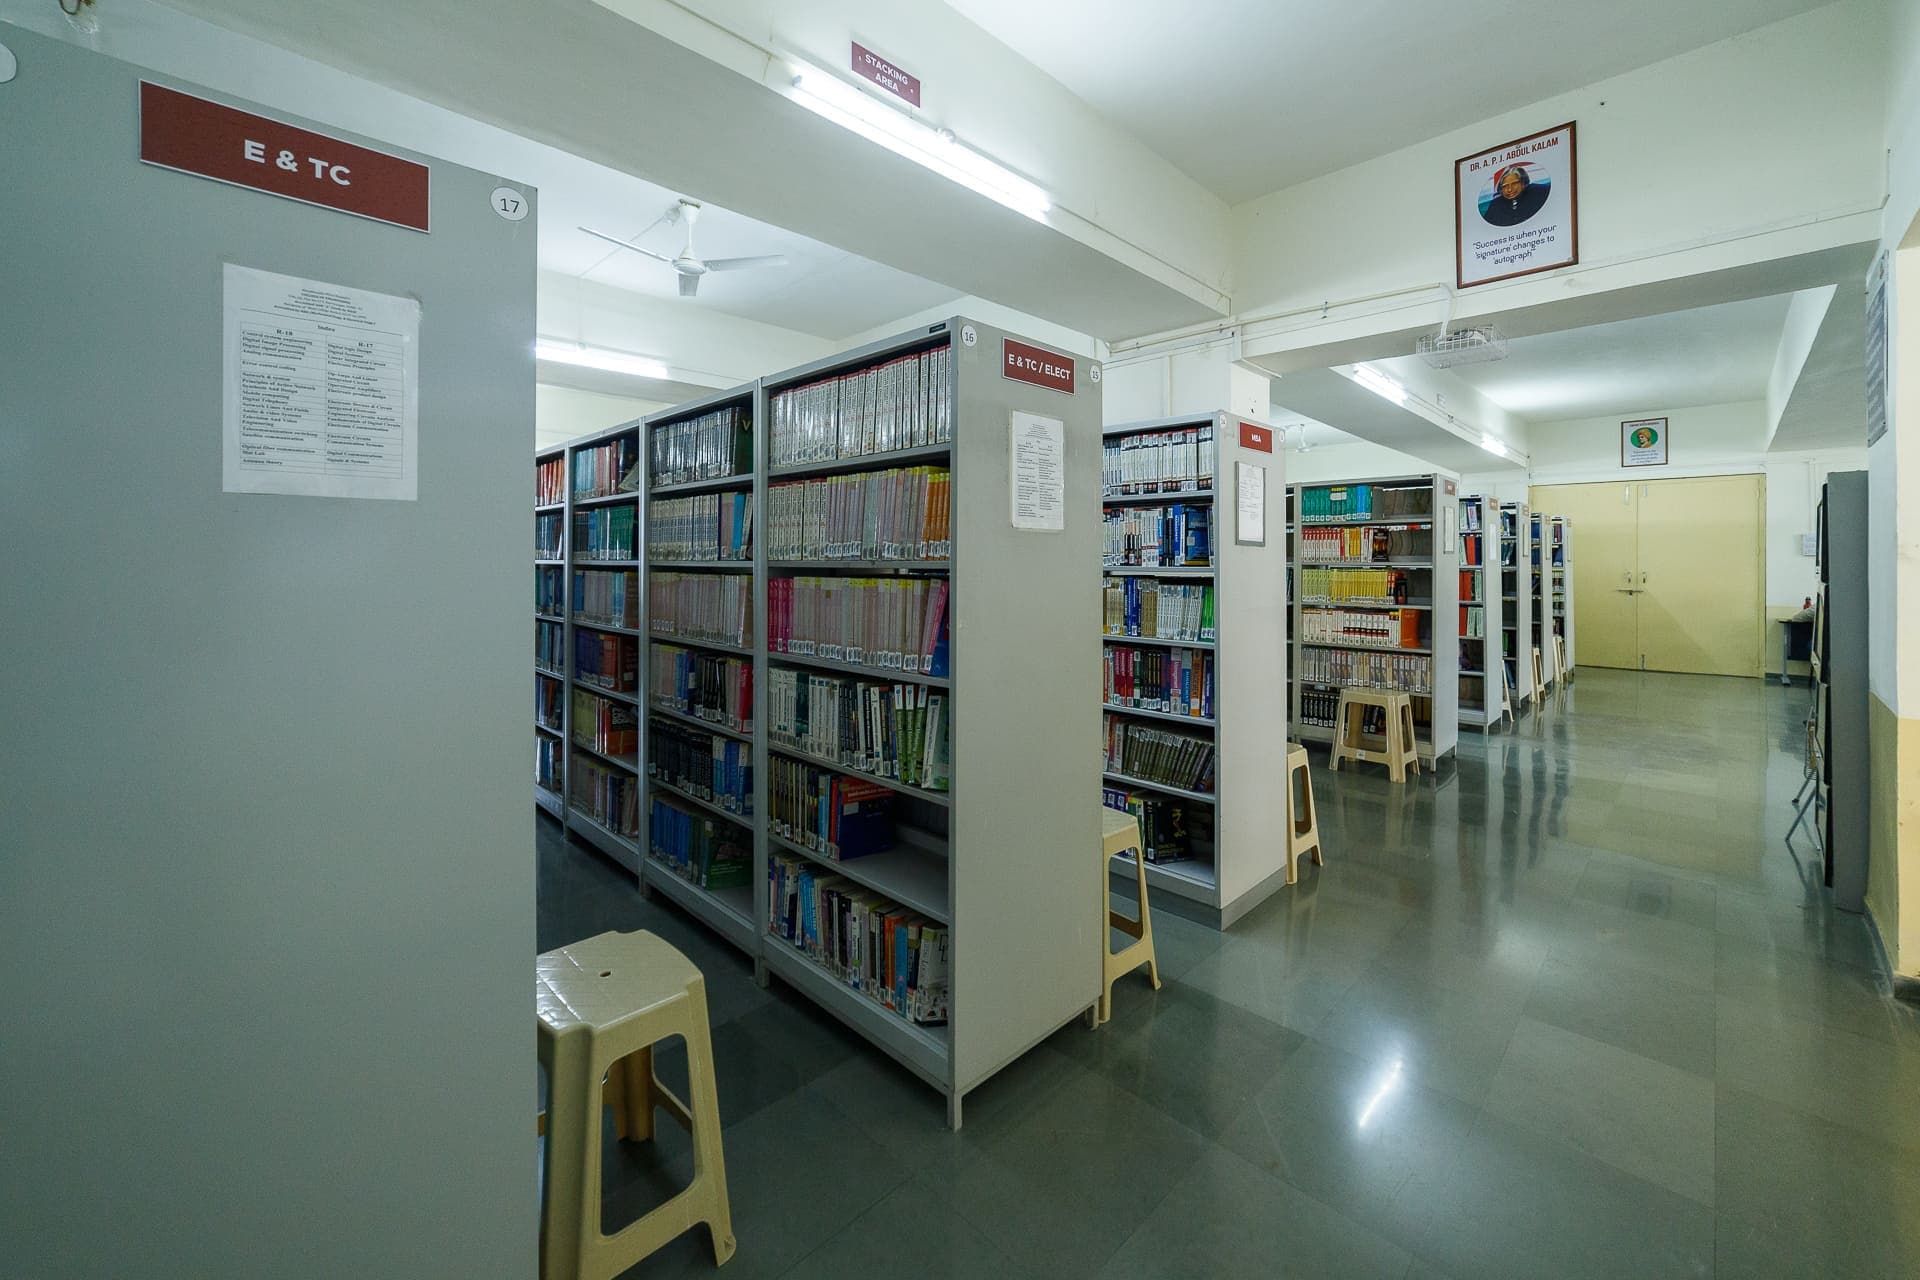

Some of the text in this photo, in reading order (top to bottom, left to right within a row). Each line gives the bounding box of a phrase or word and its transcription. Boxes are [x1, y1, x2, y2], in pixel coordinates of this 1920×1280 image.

[865, 54, 908, 85] STACKING
[876, 73, 899, 92] AREA
[244, 139, 351, 186] E & TC
[1470, 163, 1481, 172] DR.
[1492, 156, 1497, 165] P.
[1506, 147, 1530, 160] ABDUL
[1532, 137, 1558, 152] KALAM
[500, 198, 519, 213] 17
[1516, 230, 1536, 240] when
[1538, 225, 1557, 237] your
[1513, 238, 1545, 249] changes
[965, 332, 974, 342] 16
[1008, 354, 1071, 380] E & TC / ELECT
[1251, 433, 1262, 443] MBA
